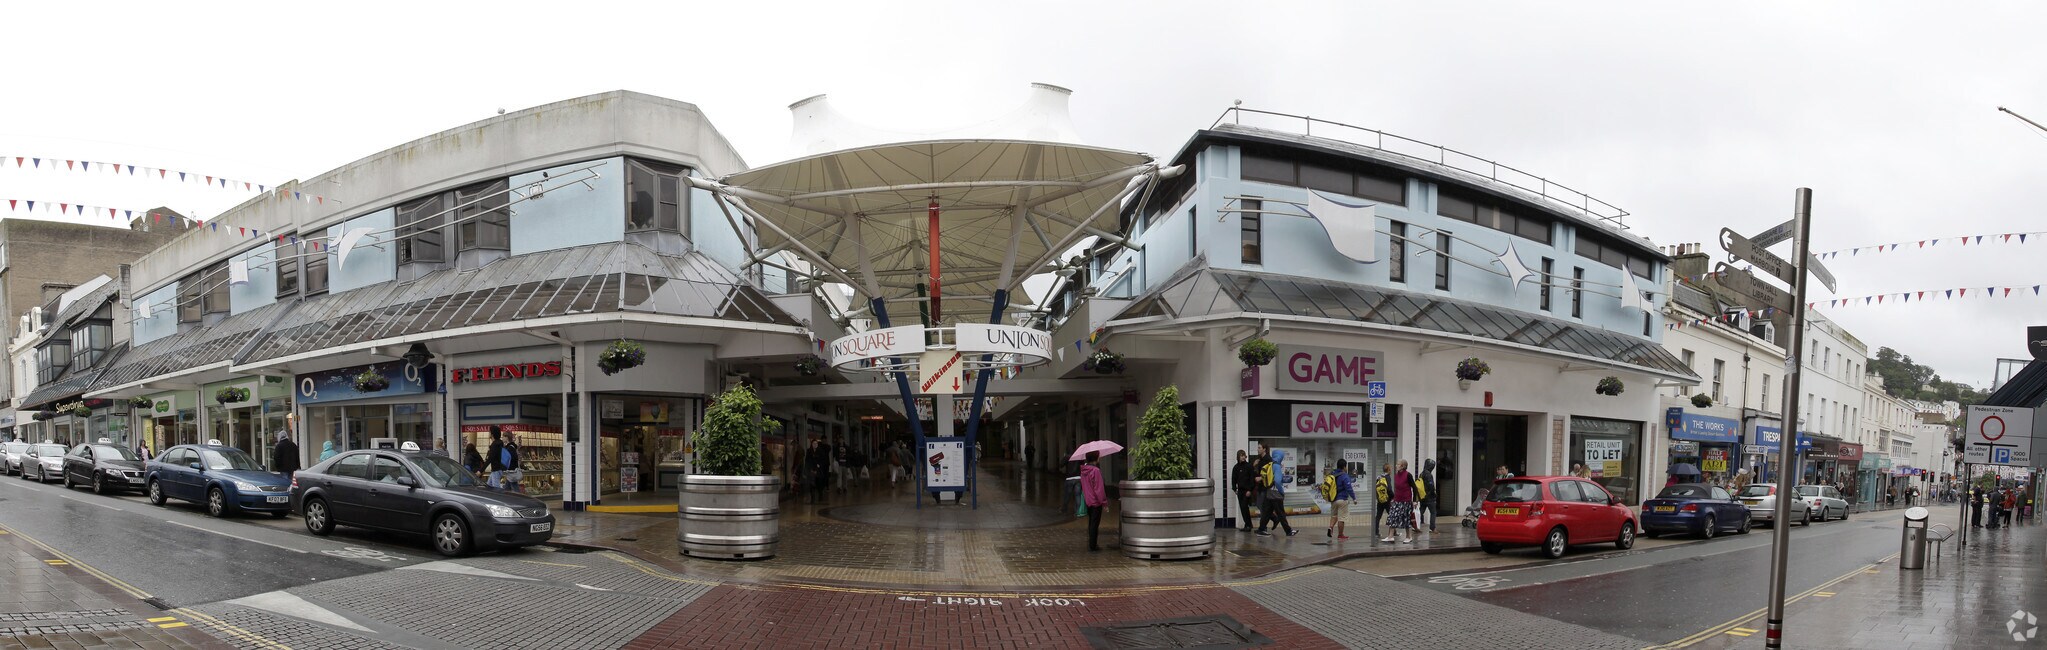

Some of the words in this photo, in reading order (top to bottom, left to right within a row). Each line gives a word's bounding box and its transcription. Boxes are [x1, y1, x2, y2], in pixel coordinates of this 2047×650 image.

[1751, 244, 1765, 258] POST
[1765, 252, 1782, 267] OFFICE
[1750, 276, 1764, 291] TOWN
[1765, 284, 1778, 297] HALL
[1752, 288, 1775, 304] LIBRARY
[451, 360, 562, 384] F.HINDS
[1288, 352, 1376, 386] GAME
[1296, 410, 1359, 434] GAME
[1692, 420, 1704, 429] THE
[1705, 421, 1725, 432] WORKS
[1586, 441, 1605, 449] RETAIL
[1607, 441, 1621, 449] UNIT
[1354, 452, 1366, 460] EXTRA
[1587, 449, 1599, 460] TO
[1602, 449, 1621, 460] LET
[933, 596, 1003, 607] RIGHT
[1025, 598, 1087, 607] LOOK
